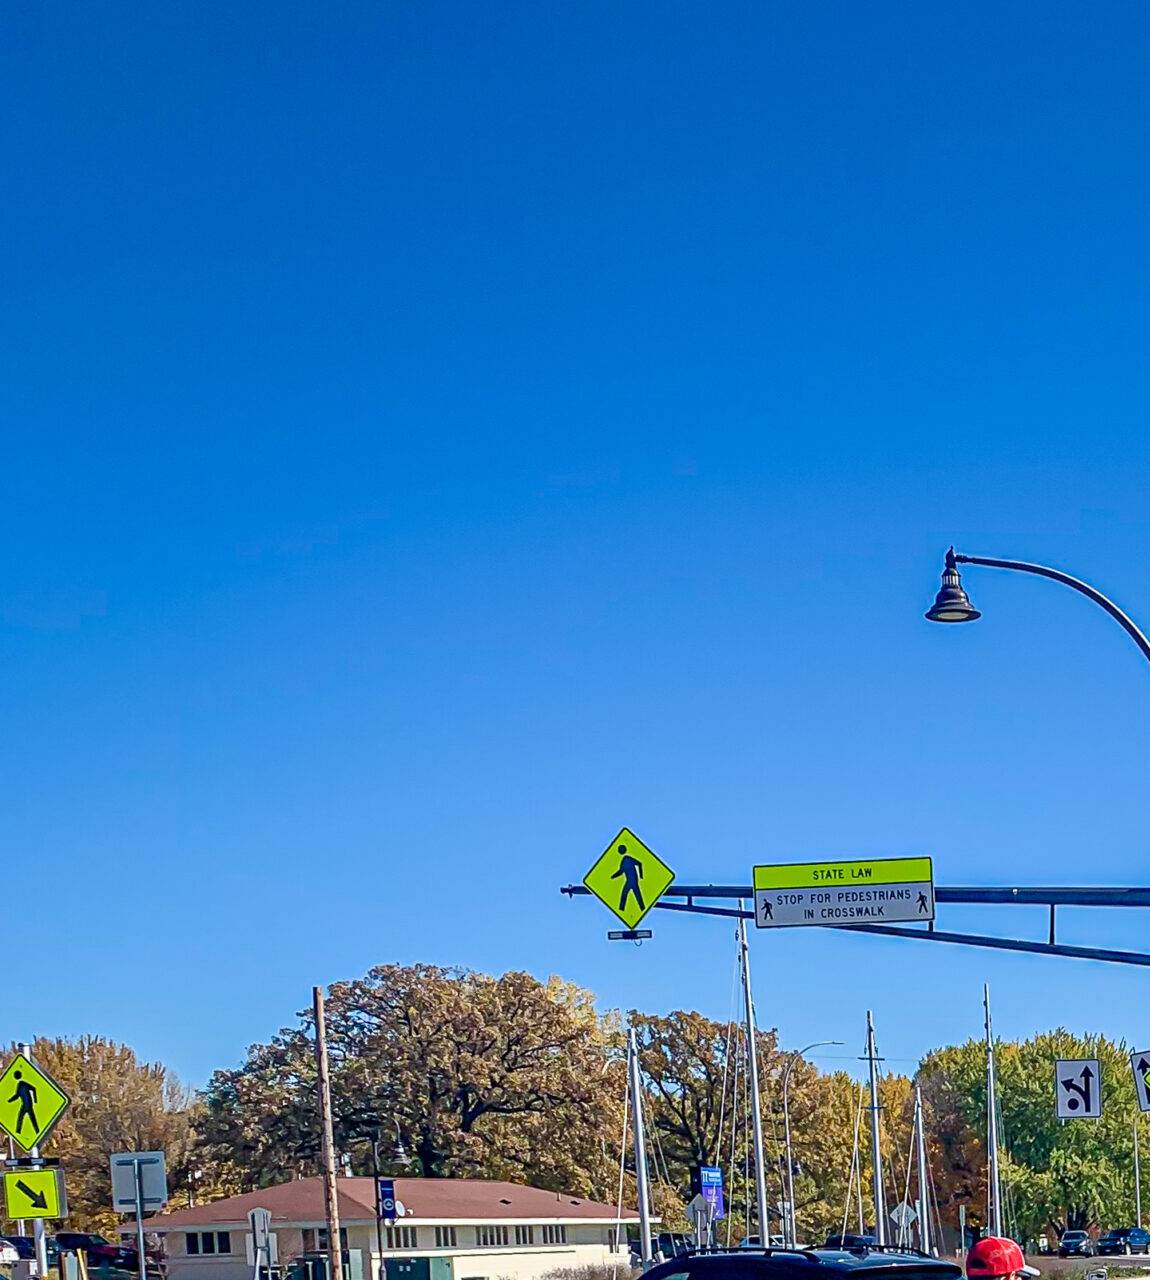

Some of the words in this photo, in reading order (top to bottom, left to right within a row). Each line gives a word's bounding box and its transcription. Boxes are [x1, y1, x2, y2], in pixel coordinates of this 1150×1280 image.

[812, 869, 844, 880] STATE
[851, 868, 872, 878] LAW
[777, 894, 804, 905] STOP
[810, 893, 831, 903] FOR
[838, 889, 911, 903] PEDESTRIANS
[804, 909, 814, 919] IN
[821, 906, 884, 918] CROSSWALK
